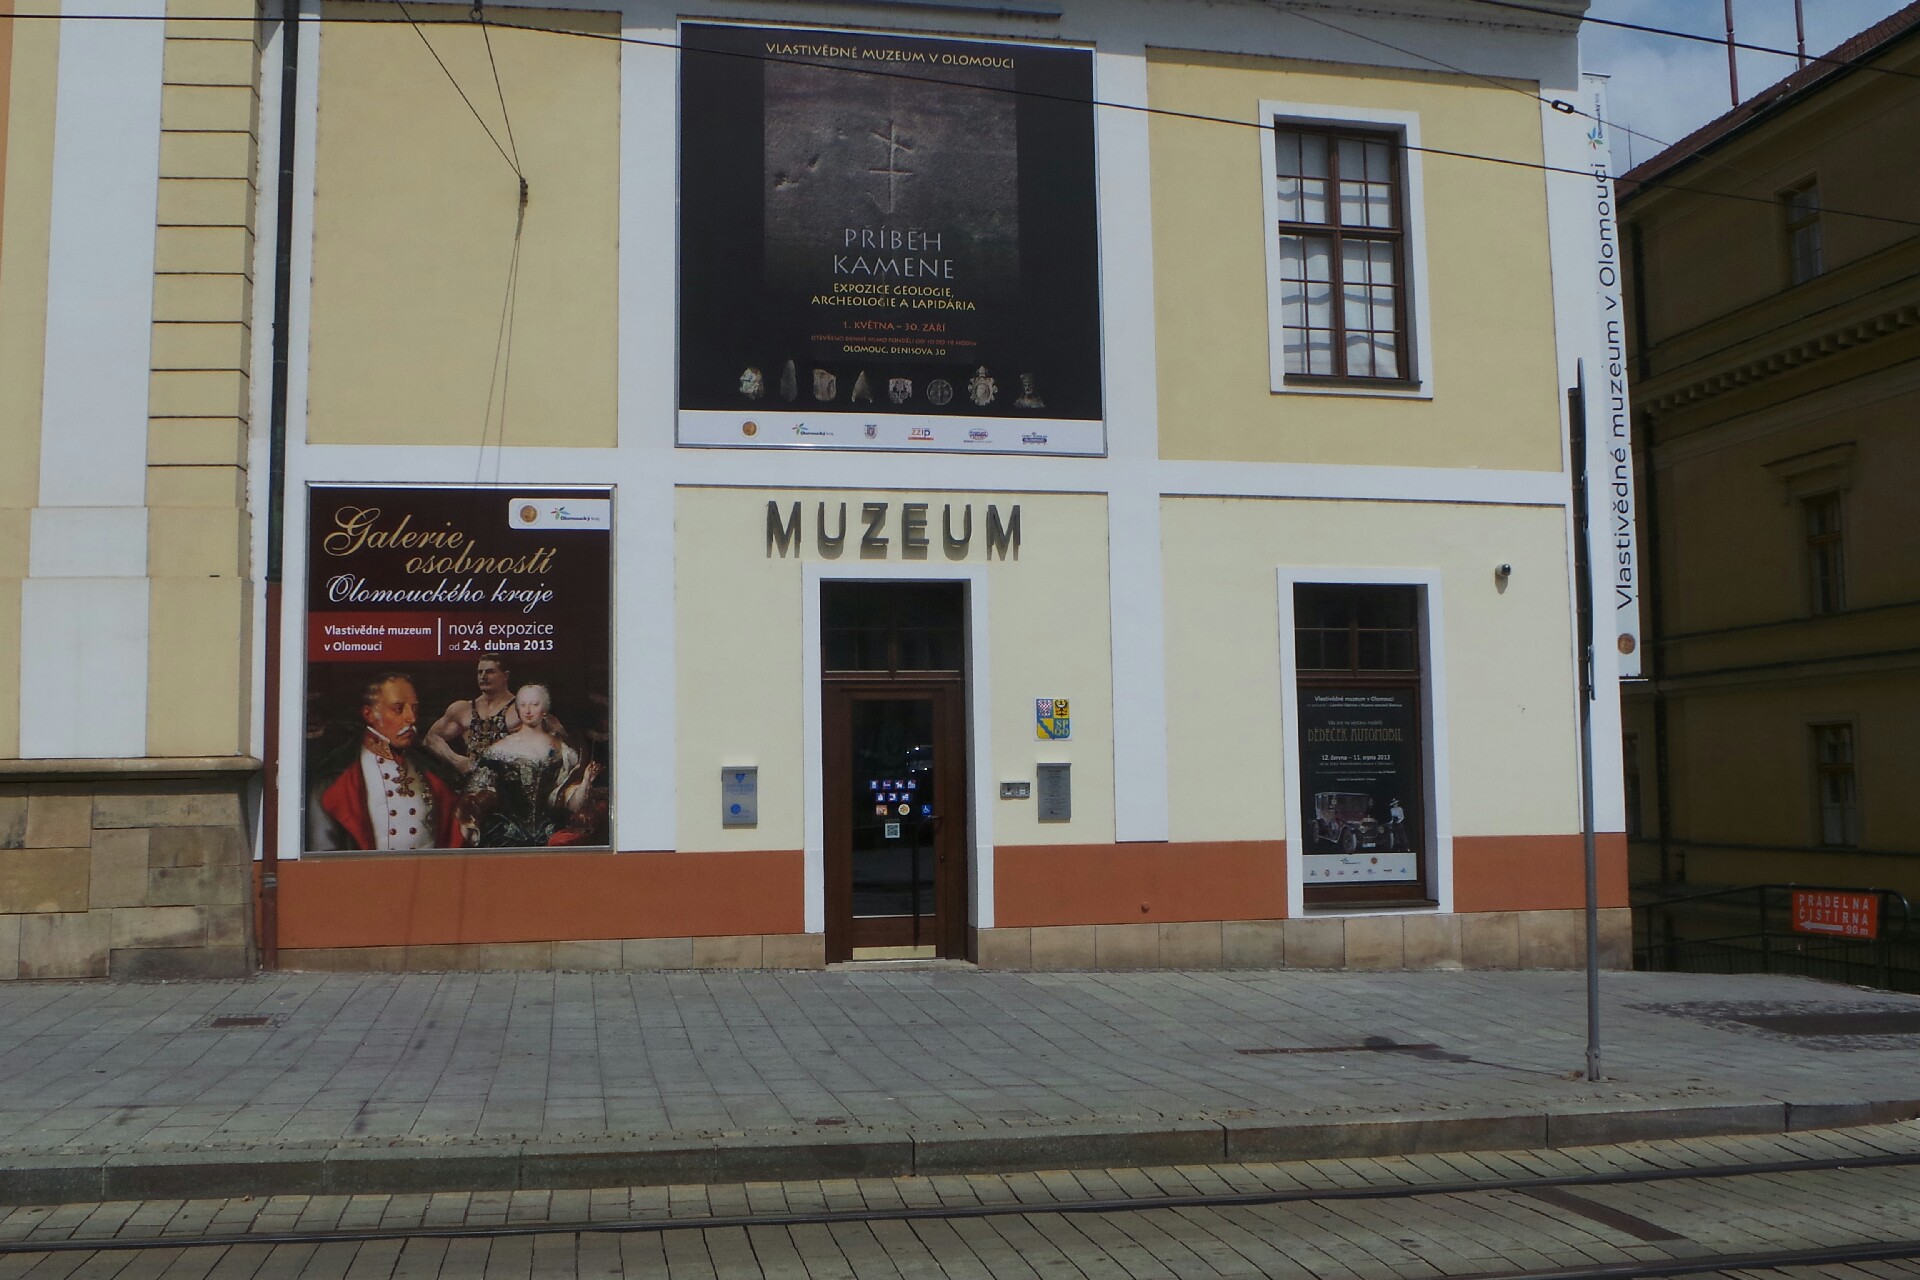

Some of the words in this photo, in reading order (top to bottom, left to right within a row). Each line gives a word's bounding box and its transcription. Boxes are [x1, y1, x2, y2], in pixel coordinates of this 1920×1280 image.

[766, 43, 858, 59] VLASTIVĚDNÉ
[862, 49, 925, 63] MUZEUM
[929, 53, 938, 64] V
[942, 54, 1015, 69] OLOMOUCI
[845, 225, 941, 251] PŘÍBĚH
[1591, 164, 1615, 287] Olomouci
[834, 254, 954, 279] KAMENE
[811, 295, 896, 308] ARCHEOLOGIE
[899, 298, 909, 308] A
[912, 298, 976, 311] LAPIDÁRIA
[834, 283, 890, 295] EXPOZICE
[893, 285, 954, 298] GEOLOGIE,
[1605, 296, 1617, 311] v
[843, 321, 851, 329] 1.
[854, 320, 895, 330] KVĚTNA
[905, 323, 920, 331] 30.
[923, 321, 945, 332] ZÁŘÍ
[891, 347, 933, 356] DENISOVA
[1606, 320, 1625, 437] muzeum
[324, 506, 464, 556] Galerie
[767, 500, 1021, 547] MUZEUM
[1610, 447, 1632, 610] Vlastivědné
[405, 540, 557, 574] osobností
[326, 573, 485, 603] Olomouckého
[490, 578, 553, 613] kraje
[324, 624, 385, 635] Vlastivědné
[388, 627, 432, 635] muzeum
[449, 621, 484, 635] nová
[489, 621, 554, 638] expozice
[333, 641, 382, 651] Olomouci
[449, 641, 460, 651] od
[462, 640, 481, 651] 24.
[484, 640, 520, 651] dubna
[523, 640, 554, 651] 2013
